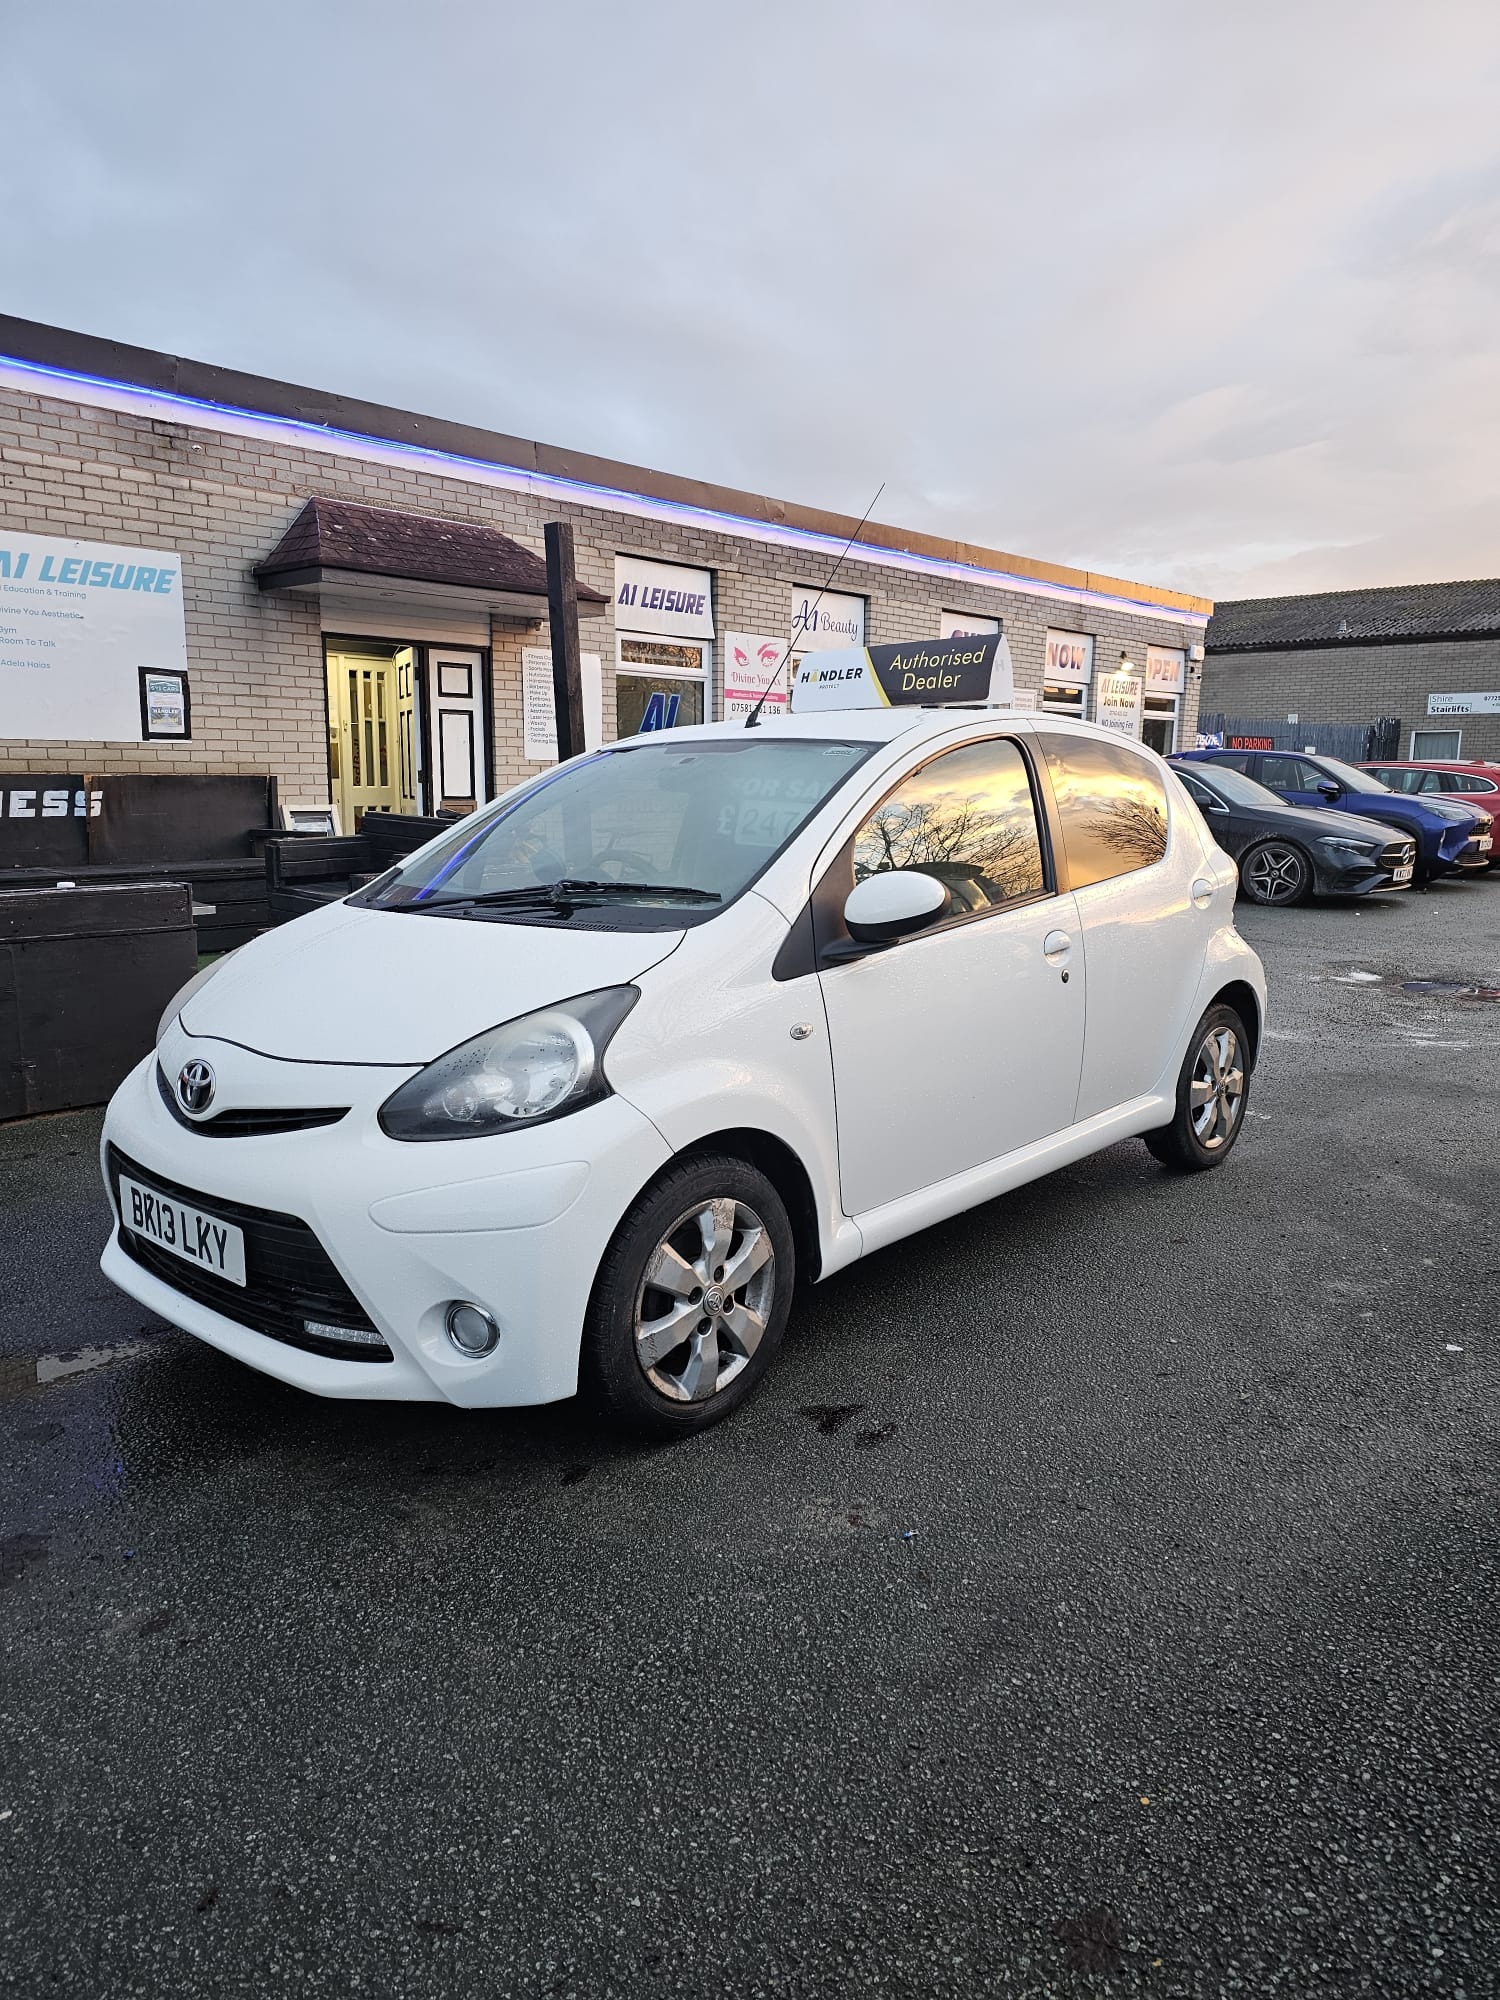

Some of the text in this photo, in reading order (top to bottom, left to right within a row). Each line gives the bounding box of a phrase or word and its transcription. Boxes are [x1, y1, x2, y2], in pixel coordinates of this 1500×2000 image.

[39, 556, 177, 594] LEISURE
[3, 584, 45, 595] Education
[46, 588, 53, 596] &
[55, 589, 87, 600] Training
[641, 587, 706, 616] LEISURE
[0, 606, 21, 615] ivine
[23, 608, 40, 616] You
[792, 600, 858, 641] A1 Beauty
[0, 636, 56, 648] Room To Talk
[1, 658, 25, 668] Adela
[889, 644, 987, 671] Authorised
[1047, 642, 1086, 670] NOW
[731, 671, 755, 684] Divine
[757, 674, 770, 687] You
[902, 669, 962, 691] Dealer
[1111, 680, 1139, 696] LEISURE
[1103, 696, 1135, 708] Join Now
[1431, 695, 1453, 703] Shire
[731, 702, 752, 713] 07581
[769, 705, 781, 715] 136
[1431, 705, 1470, 713] Stairlifts
[1231, 736, 1242, 749] NO
[1244, 737, 1272, 751] PARKING
[0, 790, 104, 818] ESS
[180, 1210, 228, 1270] LKY
